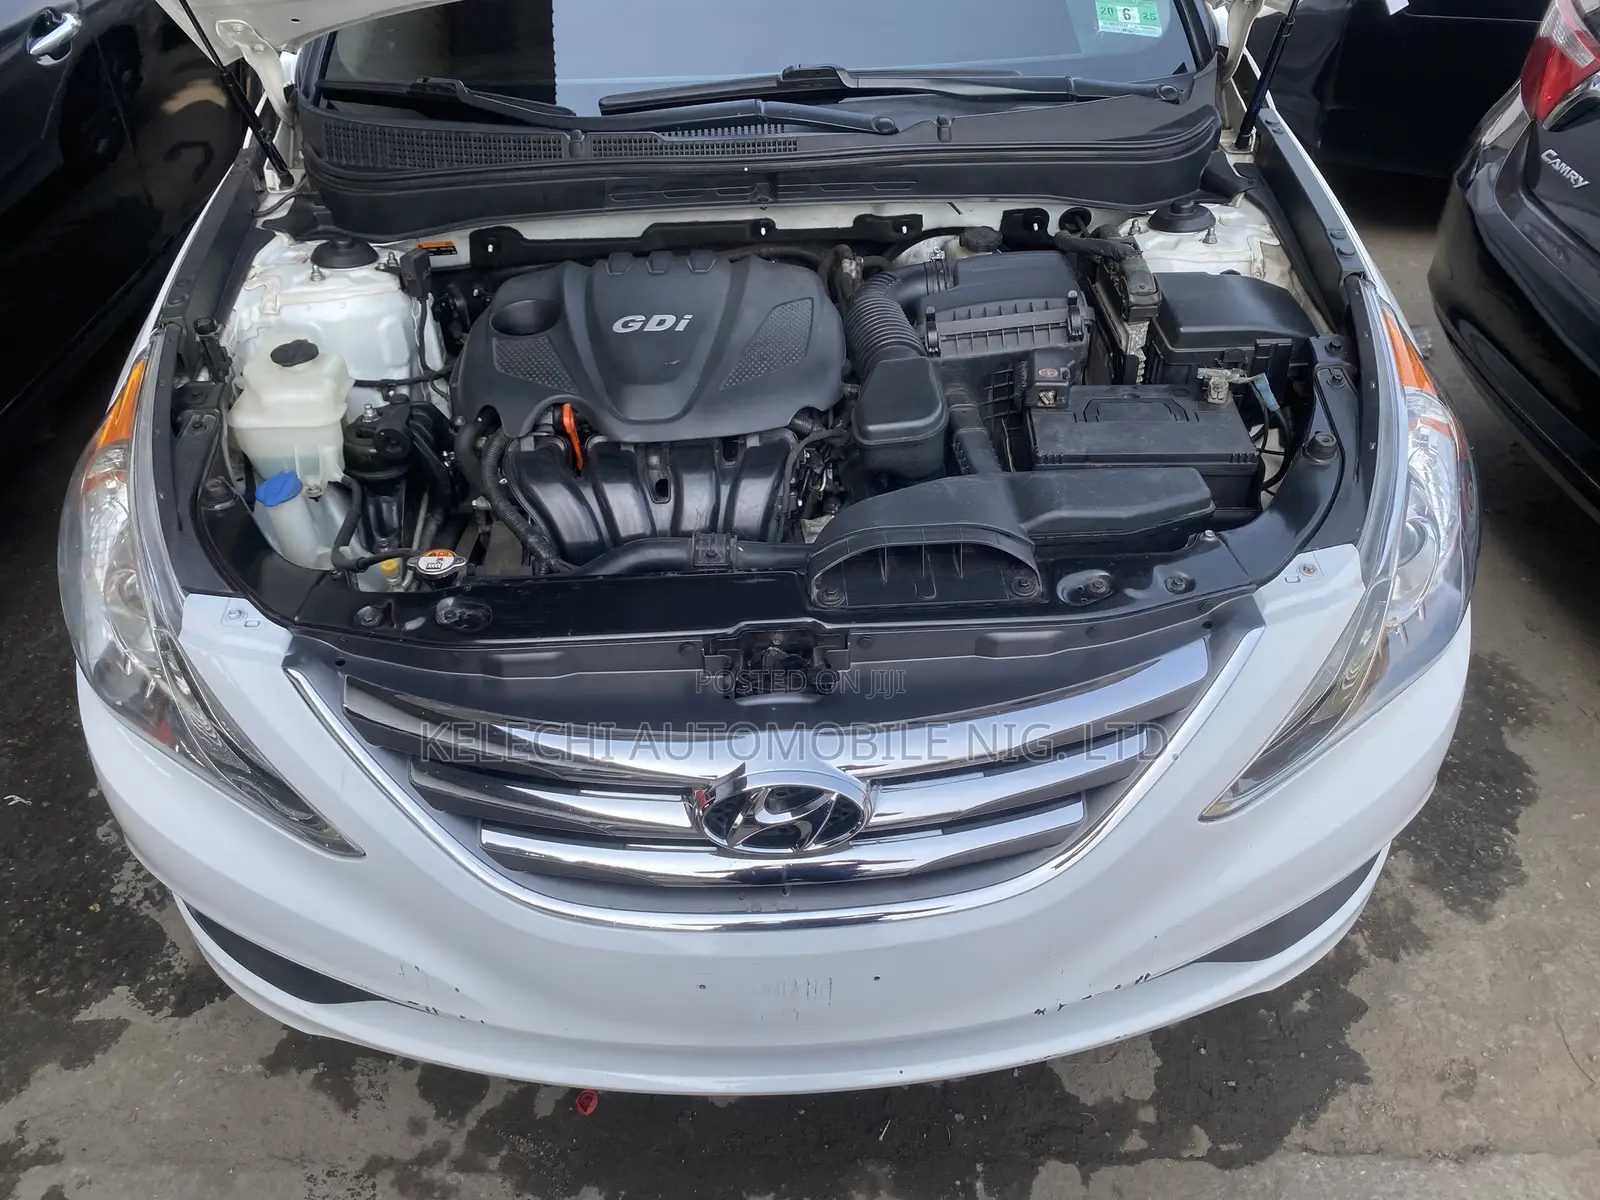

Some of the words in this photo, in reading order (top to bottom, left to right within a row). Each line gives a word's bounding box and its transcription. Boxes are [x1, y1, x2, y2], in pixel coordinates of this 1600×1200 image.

[1100, 6, 1114, 16] 20
[1122, 7, 1132, 21] 6
[1142, 12, 1157, 21] 25
[1541, 148, 1590, 189] CAMRY
[612, 314, 694, 334] GDi
